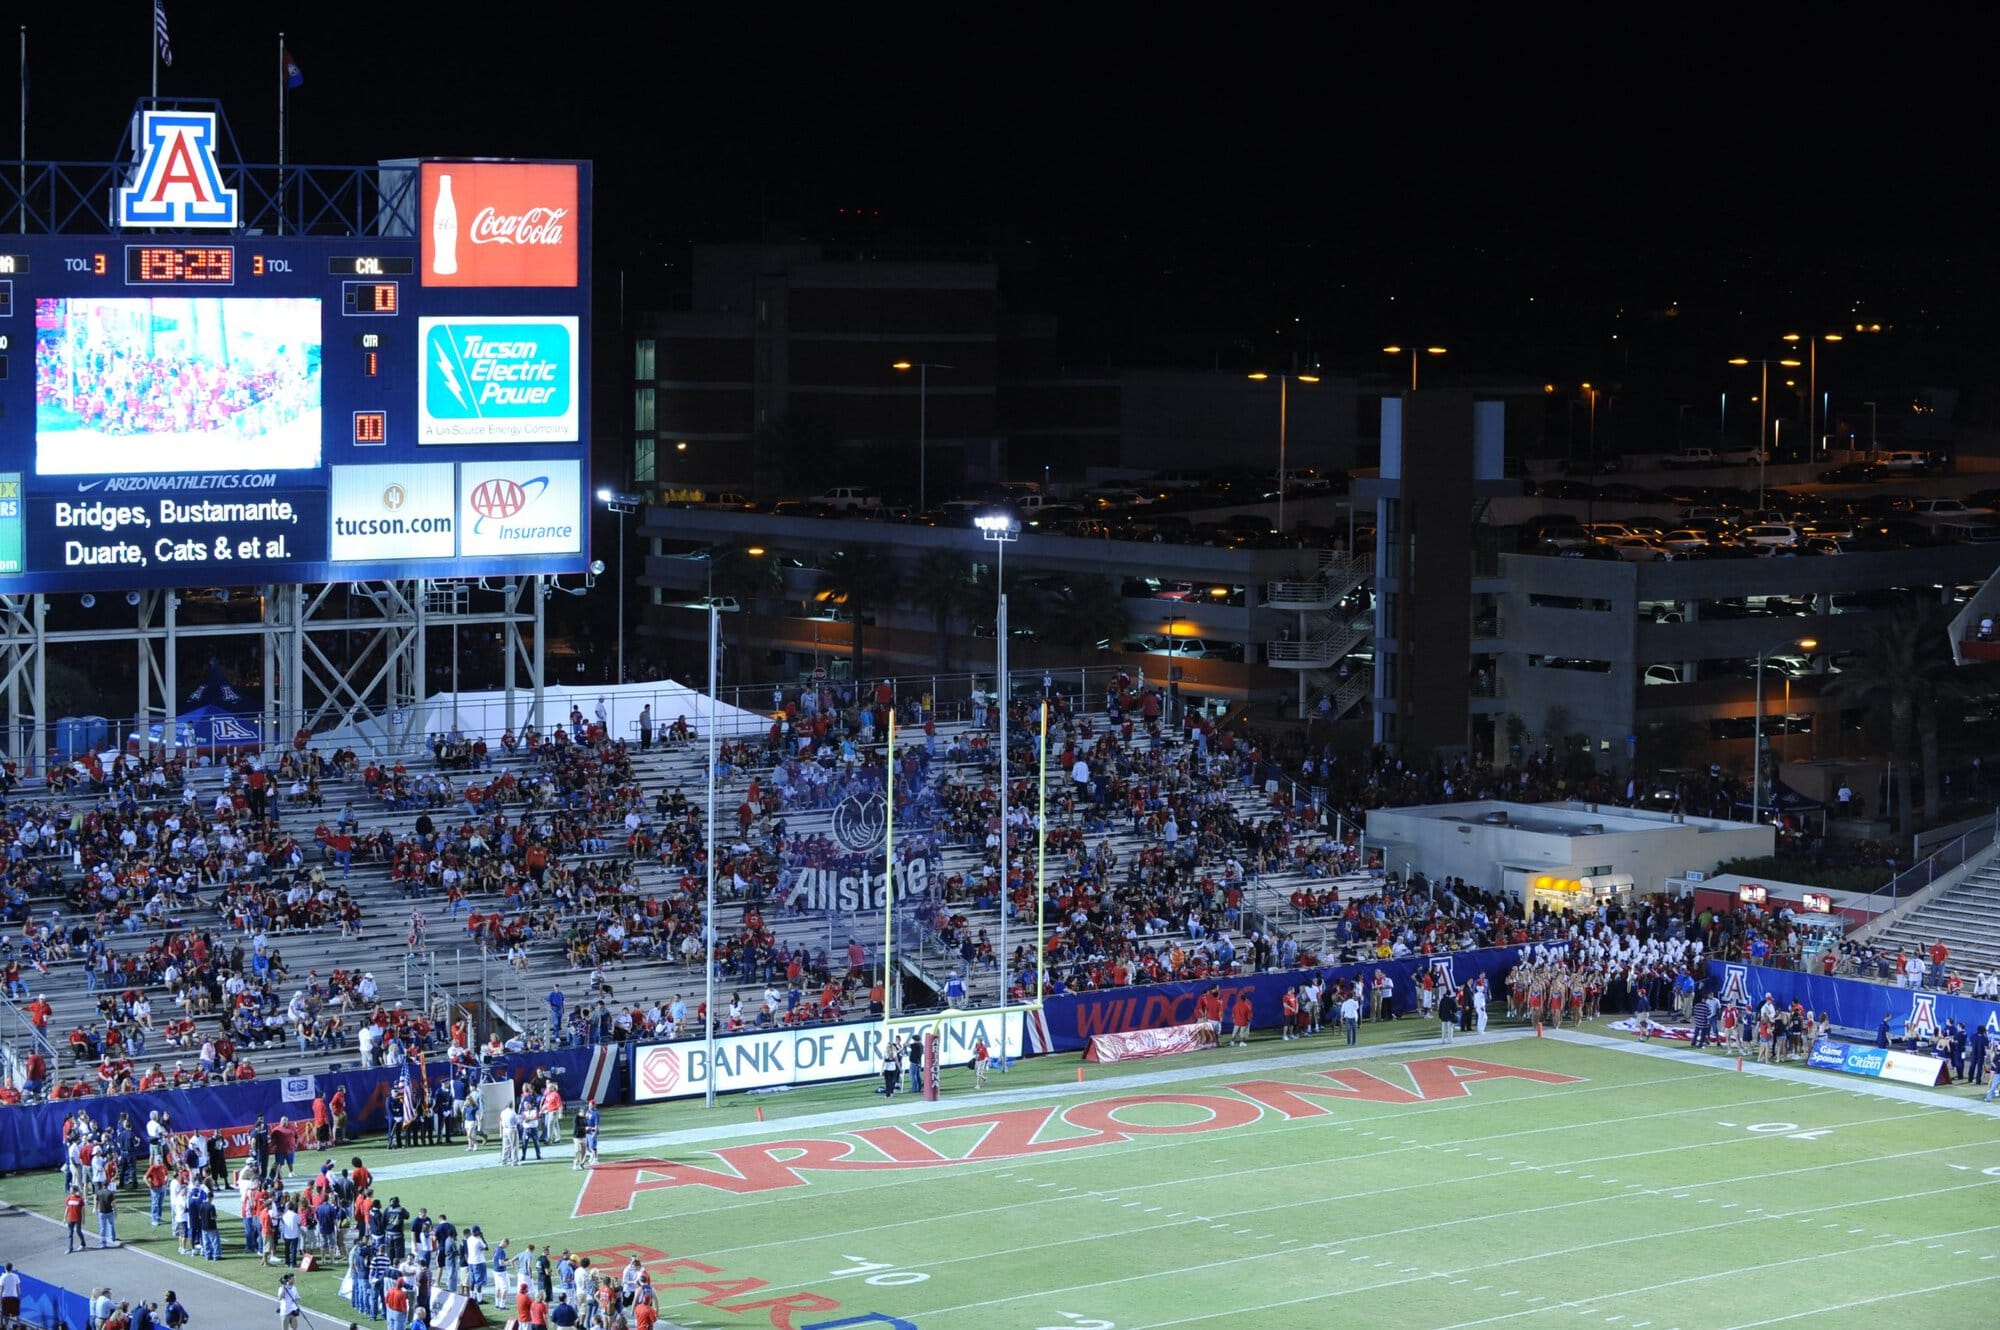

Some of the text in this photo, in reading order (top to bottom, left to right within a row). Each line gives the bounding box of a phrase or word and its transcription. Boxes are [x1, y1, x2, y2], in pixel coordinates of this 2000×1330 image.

[470, 207, 568, 244] Coca-Cola
[65, 254, 105, 274] TOL 3
[253, 255, 292, 275] 3 TOL
[355, 258, 383, 274] CAL
[375, 285, 395, 311] 0
[464, 335, 538, 359] Tucson
[471, 360, 557, 382] Electric
[479, 382, 556, 405] Power
[104, 474, 277, 492] ARIZONAATHLETICS.COM
[474, 480, 522, 519] AAA
[55, 499, 298, 531] Bridges, Bustamante,
[335, 516, 451, 536] tucson.com
[499, 524, 572, 540] Insurance
[65, 534, 291, 567] Duarte, Cats & et al.
[785, 857, 928, 912] Allstate
[1077, 985, 1255, 1038] WILDCTS
[687, 1039, 785, 1082] BANK
[794, 1035, 835, 1069] OF
[1812, 1052, 1845, 1065] Sponsor
[1819, 1045, 1842, 1056] Game
[930, 1036, 941, 1089] ARIZONA
[1848, 1056, 1881, 1070] Citizen
[571, 1056, 1590, 1218] ARIZONA
